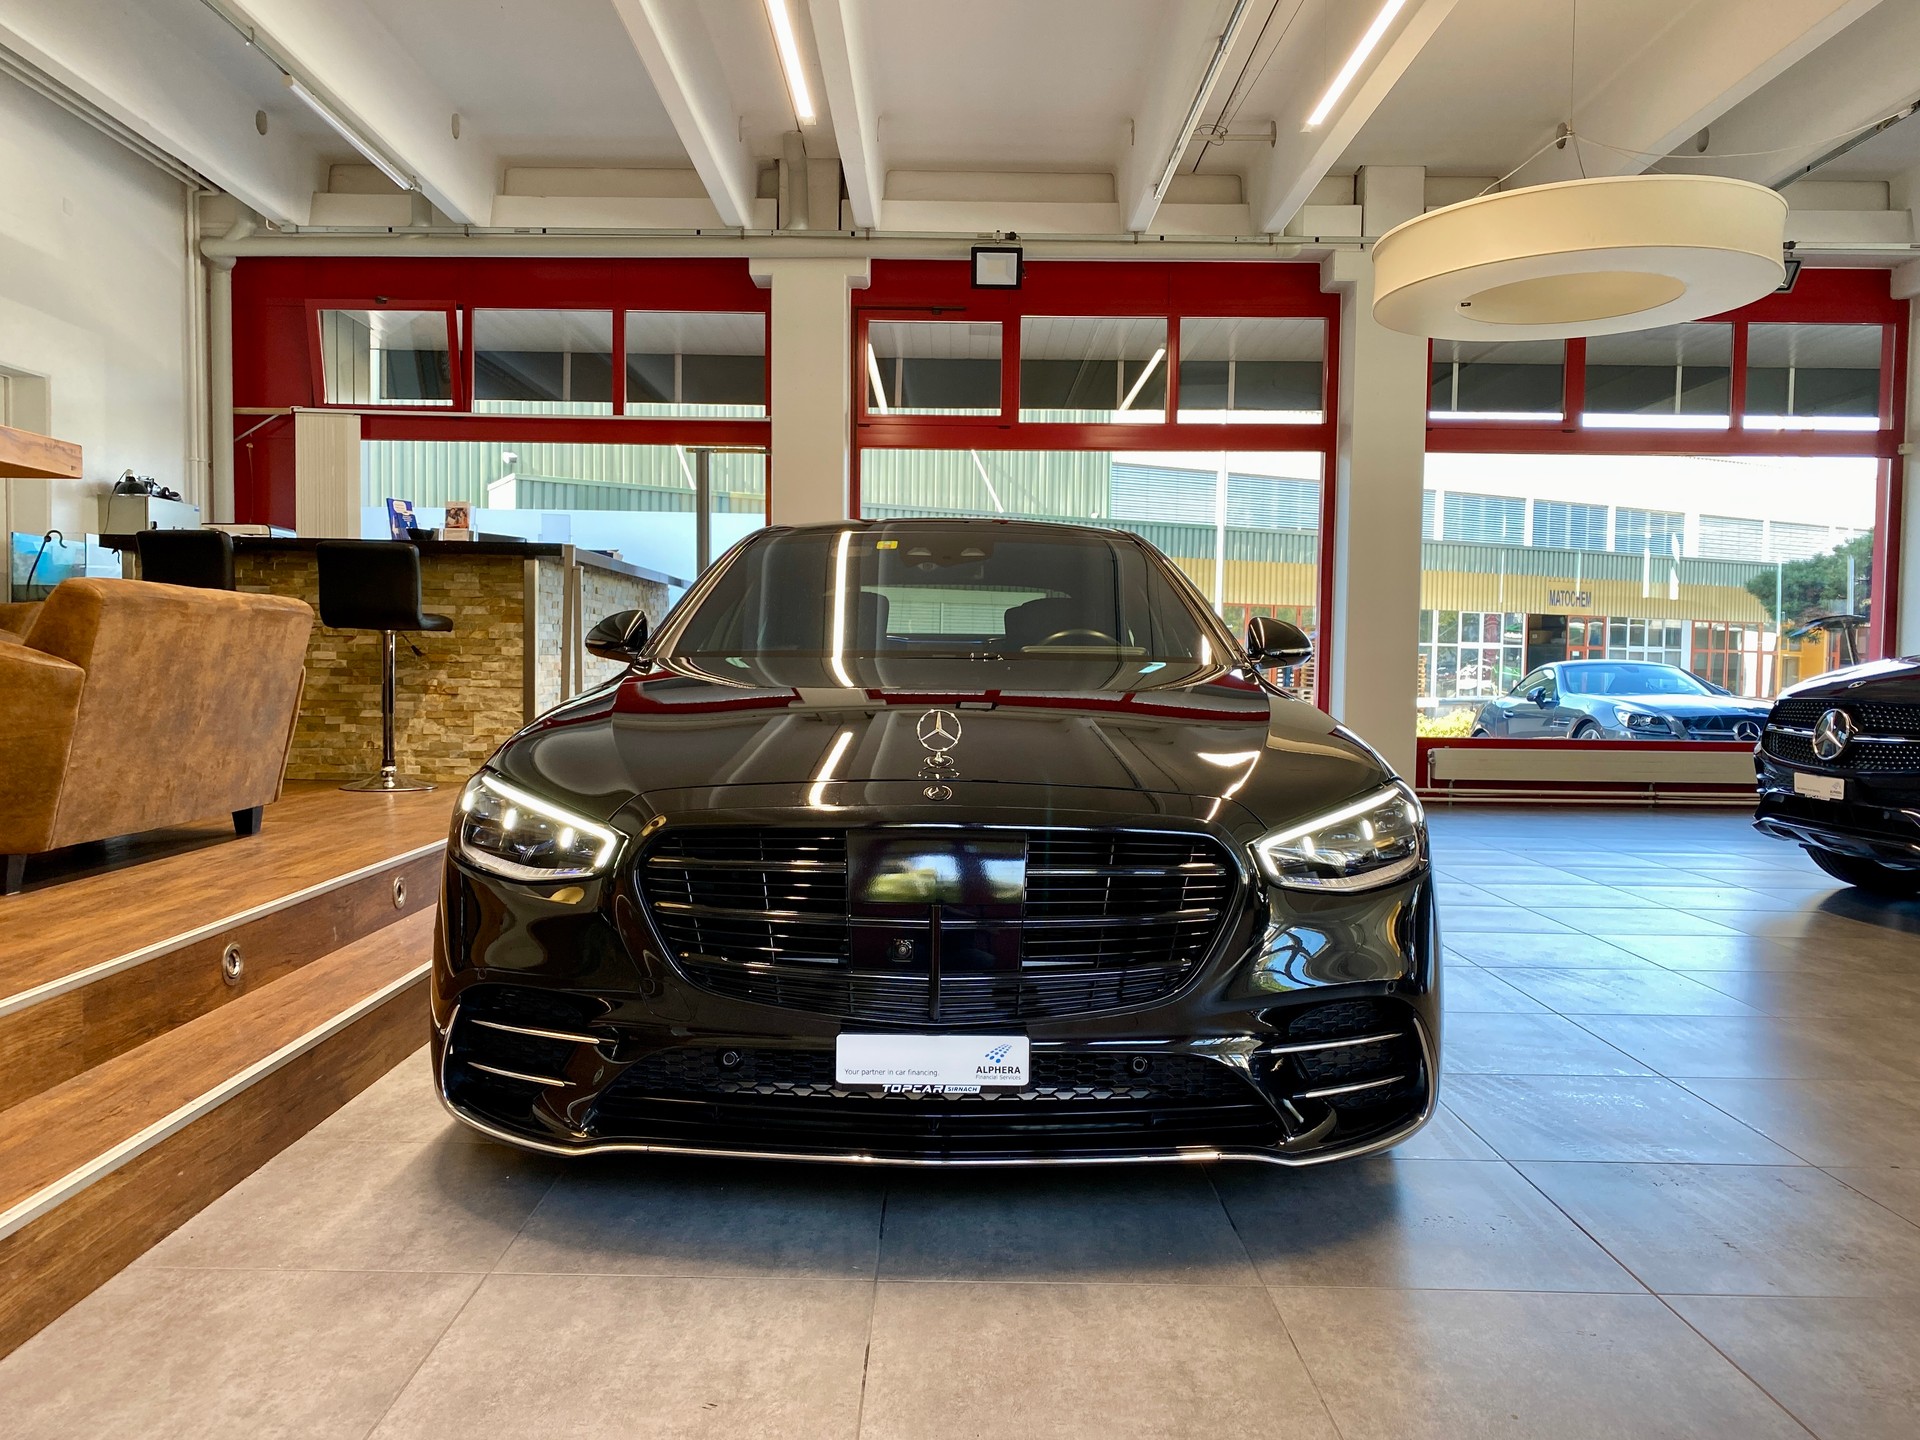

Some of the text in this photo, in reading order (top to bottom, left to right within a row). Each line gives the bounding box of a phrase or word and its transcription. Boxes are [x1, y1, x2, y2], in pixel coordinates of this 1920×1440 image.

[1549, 590, 1592, 608] MATOCHEM
[861, 1069, 886, 1077] partner
[907, 1068, 940, 1078] financing.
[976, 1066, 1021, 1074] ALPHERA
[882, 1084, 944, 1094] TOPCAR
